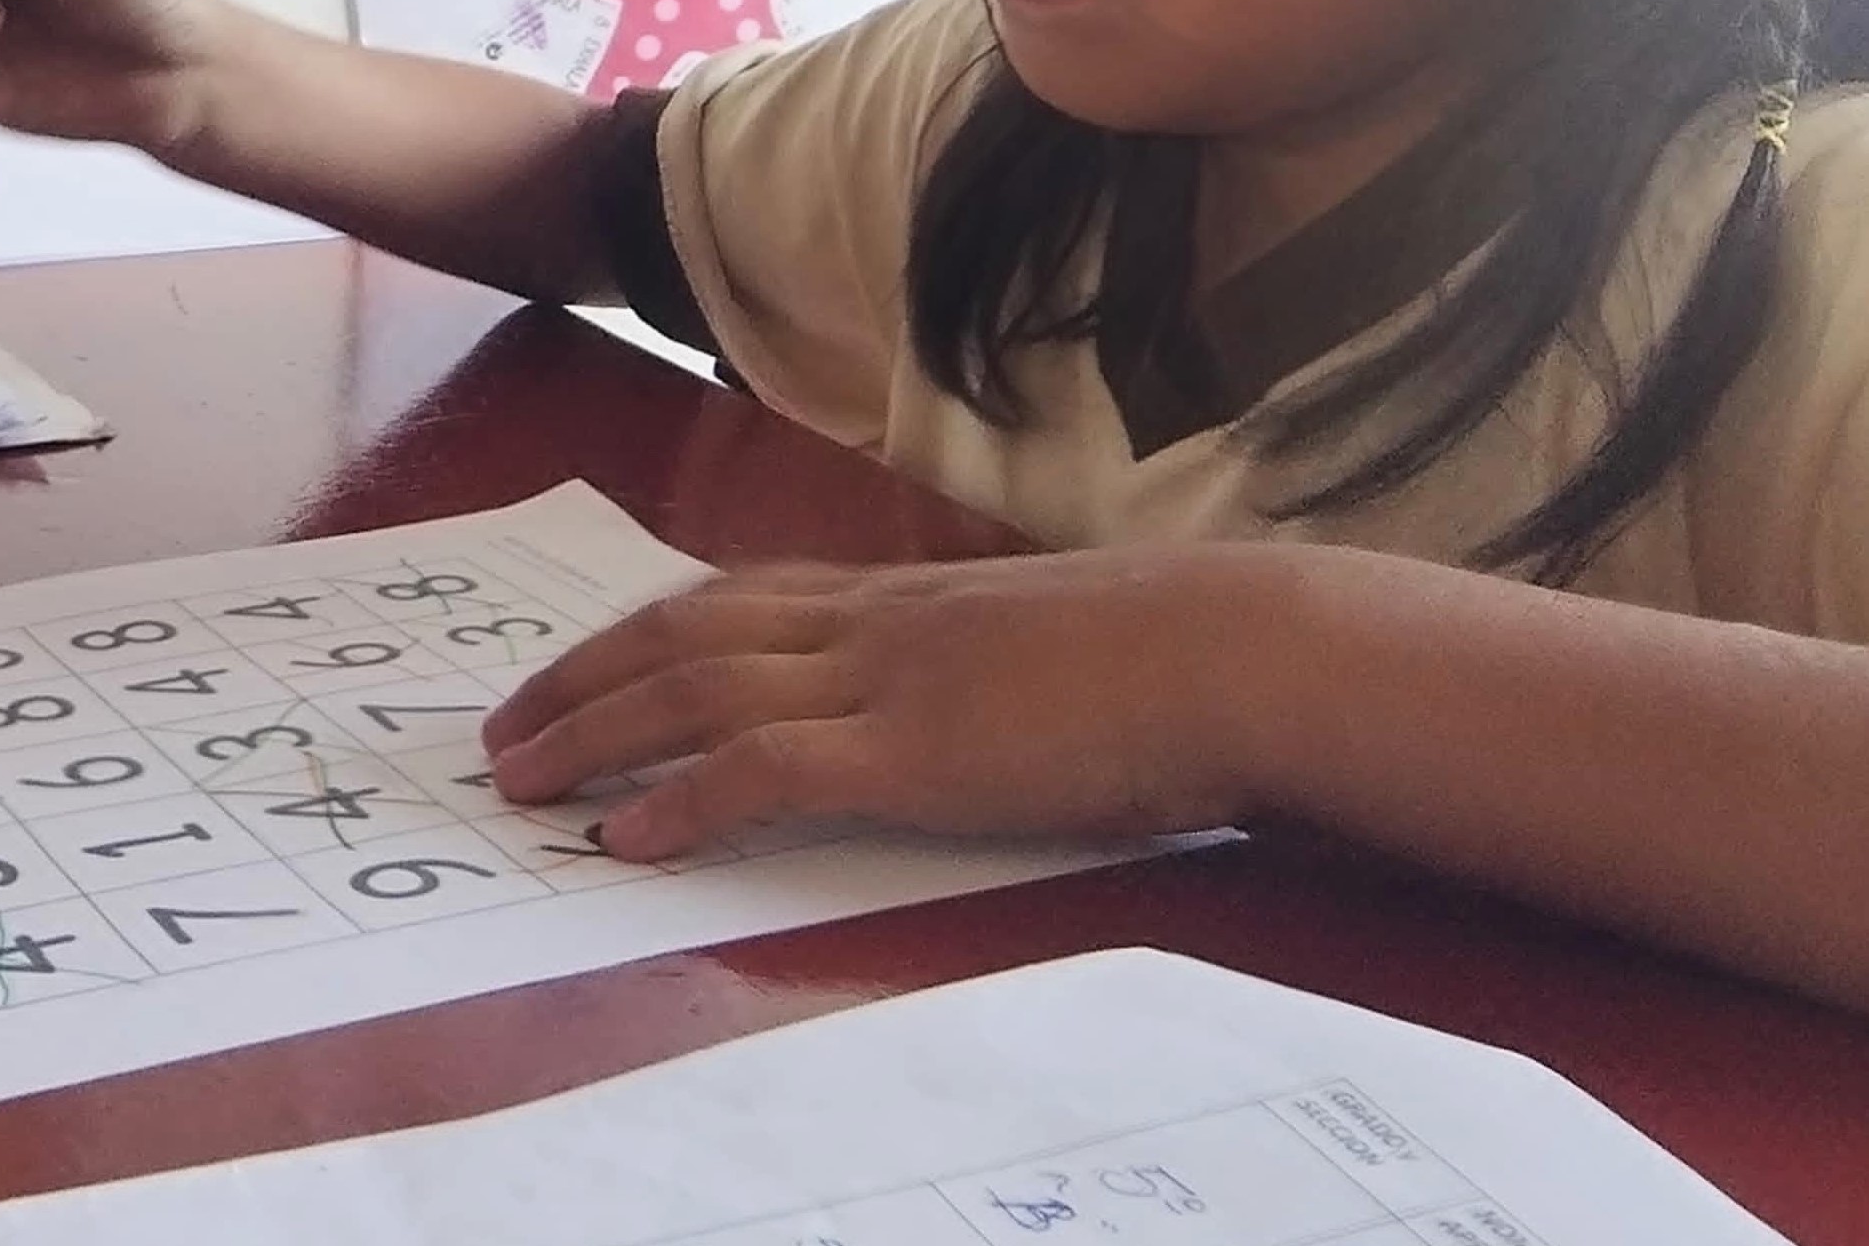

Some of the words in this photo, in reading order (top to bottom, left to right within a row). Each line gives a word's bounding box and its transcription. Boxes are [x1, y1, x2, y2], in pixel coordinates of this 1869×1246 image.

[374, 573, 479, 602] 8
[222, 595, 322, 622] 4
[70, 619, 178, 652] 8
[445, 617, 554, 647] 3
[290, 641, 402, 670] 6
[123, 667, 229, 701] 4
[358, 703, 488, 733] 7
[194, 723, 314, 762] 3
[18, 755, 145, 790] 6
[263, 786, 382, 824] 4
[81, 821, 213, 858] 1
[348, 858, 498, 901] 9
[144, 906, 302, 945] 7
[1295, 1100, 1384, 1165] SECCION
[1329, 1092, 1409, 1148] GRADO
